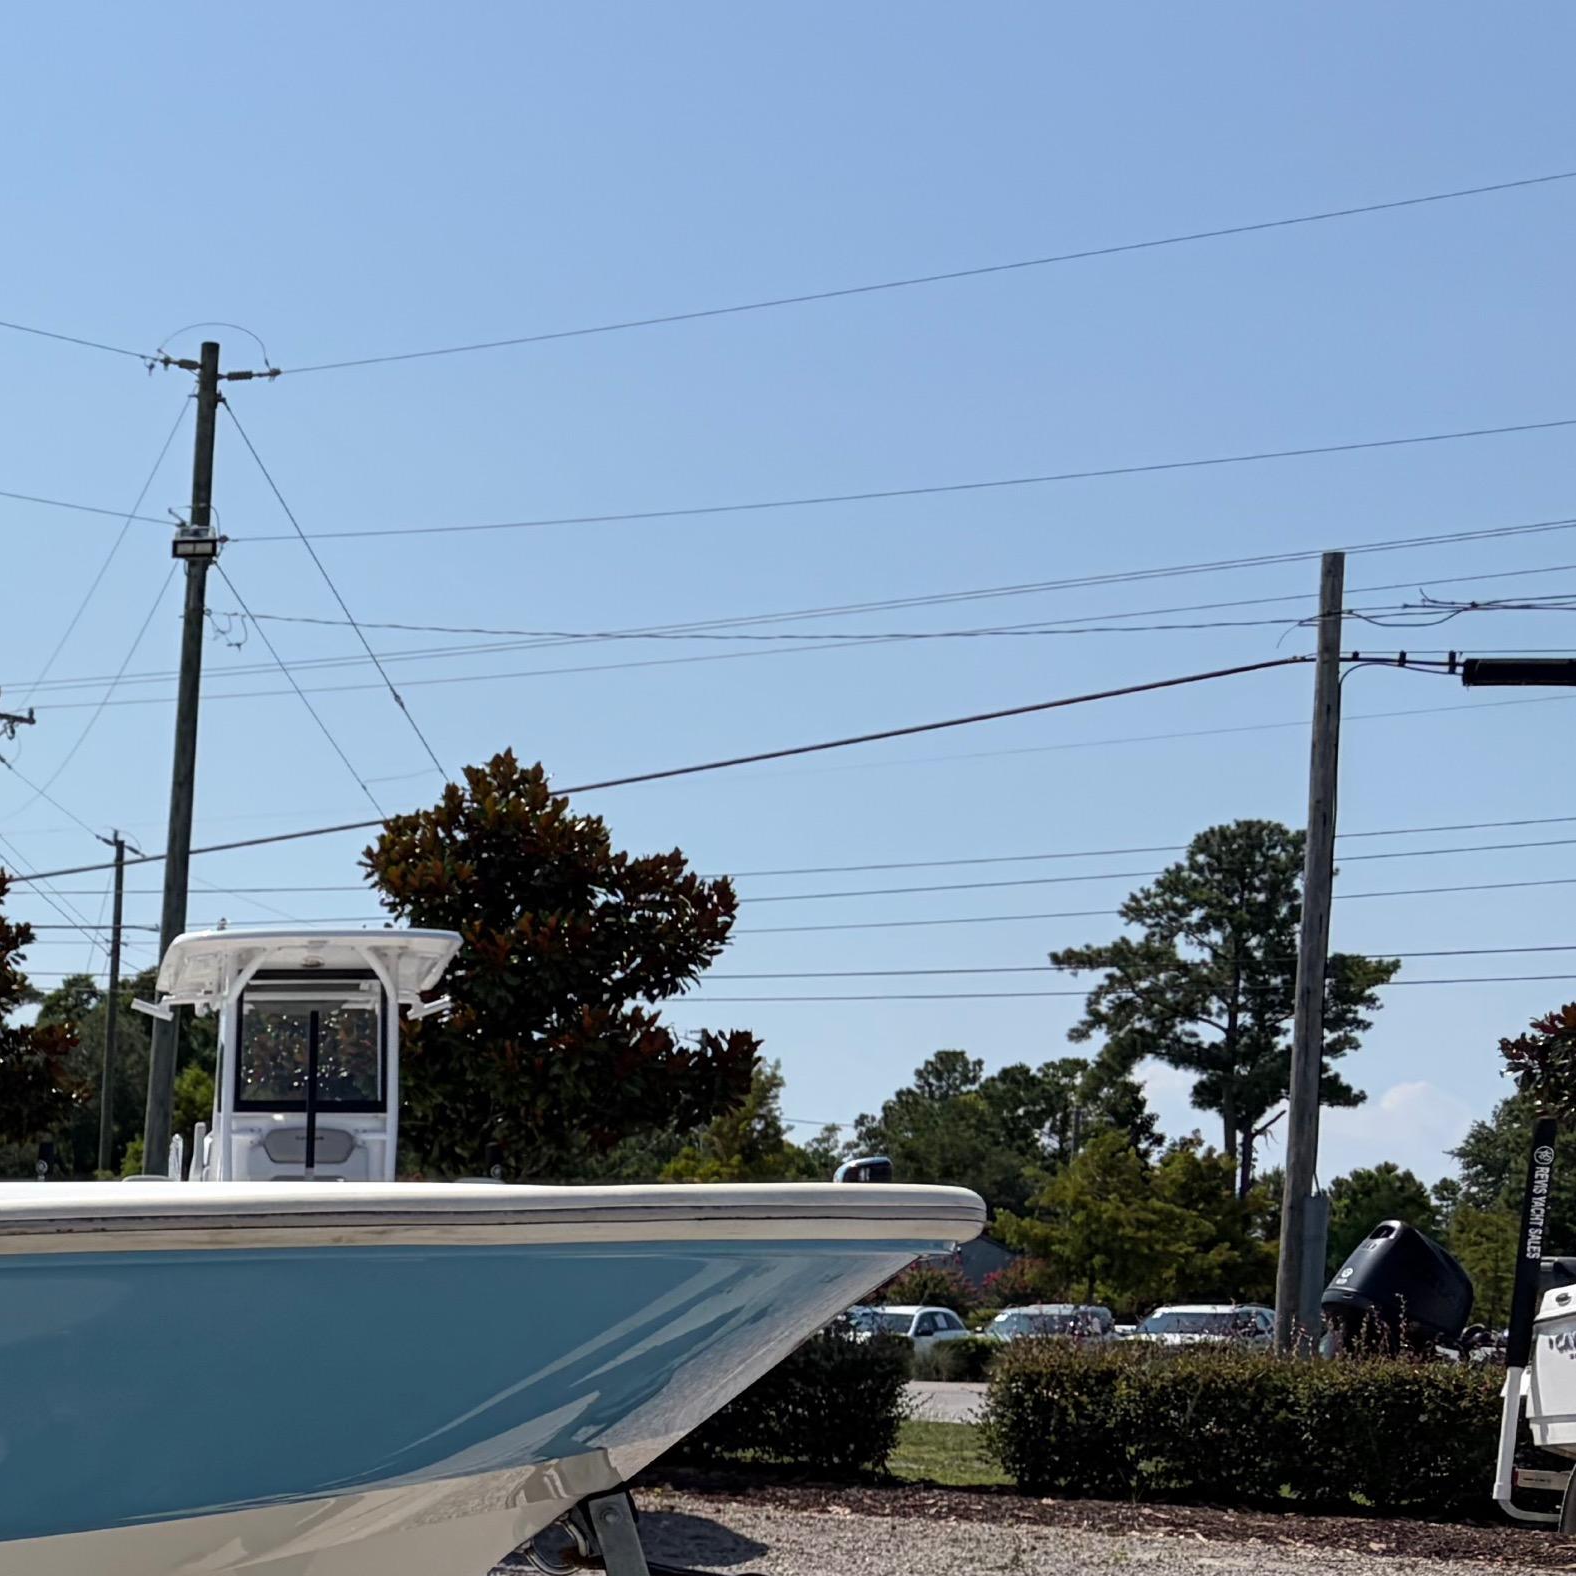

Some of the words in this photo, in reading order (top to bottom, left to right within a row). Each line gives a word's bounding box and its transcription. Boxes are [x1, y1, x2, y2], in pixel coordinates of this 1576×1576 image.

[1532, 1166, 1550, 1195] REVIS
[1529, 1196, 1547, 1226] YACHT
[1526, 1227, 1543, 1259] SALES
